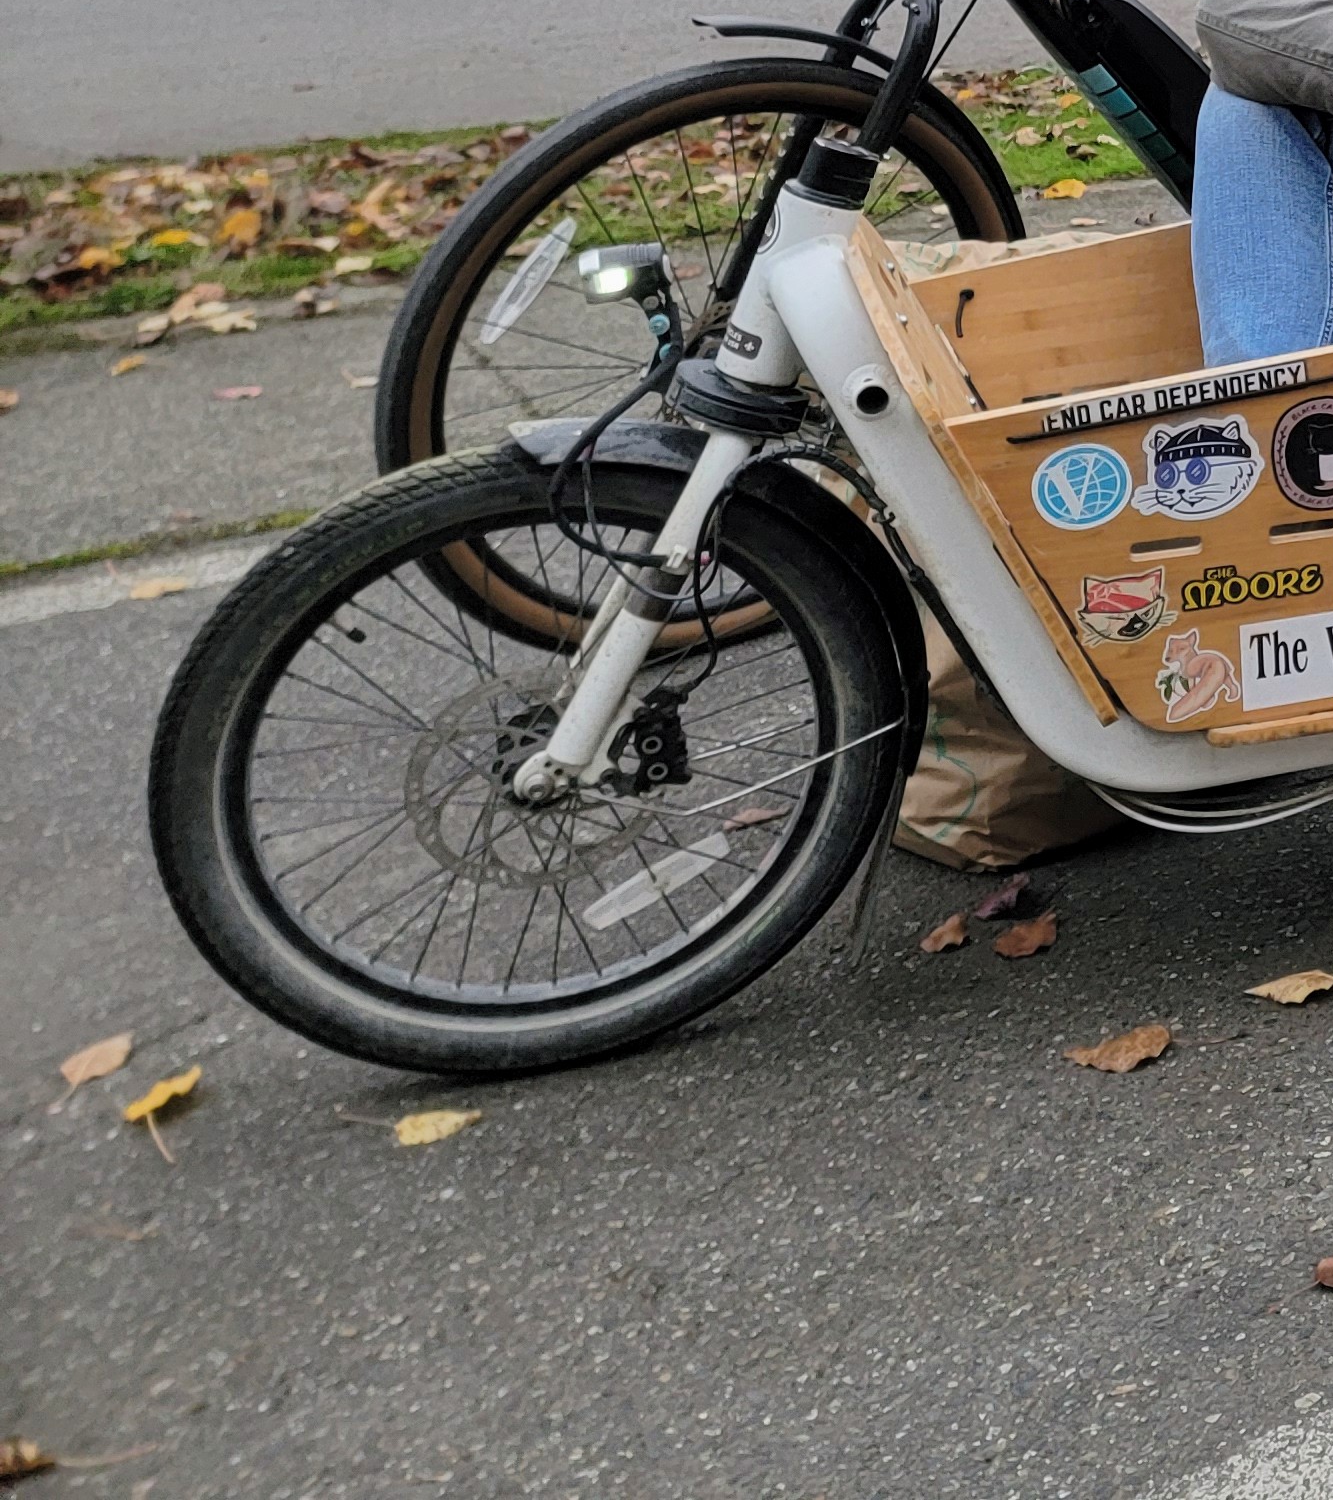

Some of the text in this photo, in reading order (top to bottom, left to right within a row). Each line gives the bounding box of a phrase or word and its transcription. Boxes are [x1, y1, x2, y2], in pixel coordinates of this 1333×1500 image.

[1047, 365, 1302, 432] END CAR DEPENDENCY
[1184, 565, 1322, 610] MOORE
[1206, 567, 1235, 580] THE
[1249, 629, 1308, 679] The
